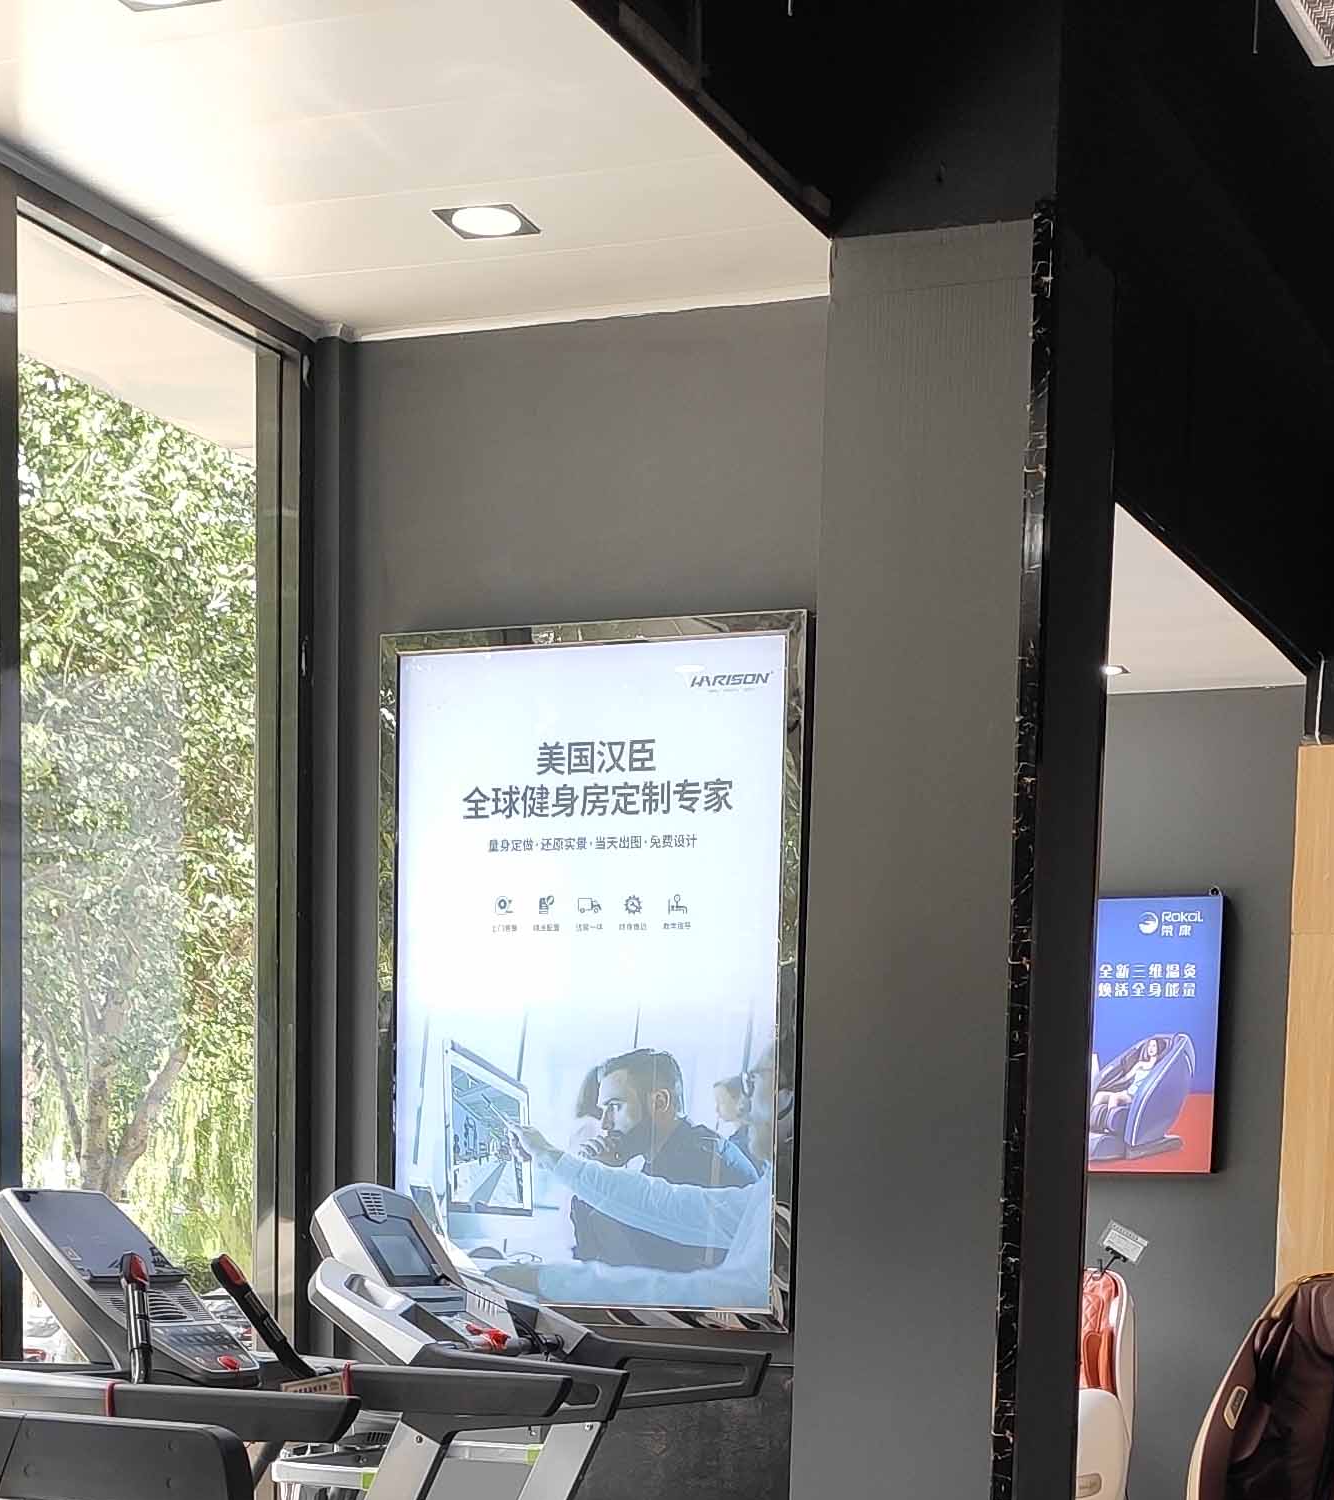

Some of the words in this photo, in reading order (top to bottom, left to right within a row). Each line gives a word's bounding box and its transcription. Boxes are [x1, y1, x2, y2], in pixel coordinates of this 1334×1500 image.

[536, 738, 657, 776] 美国汉臣
[462, 778, 733, 820] 全球健身房定制专家
